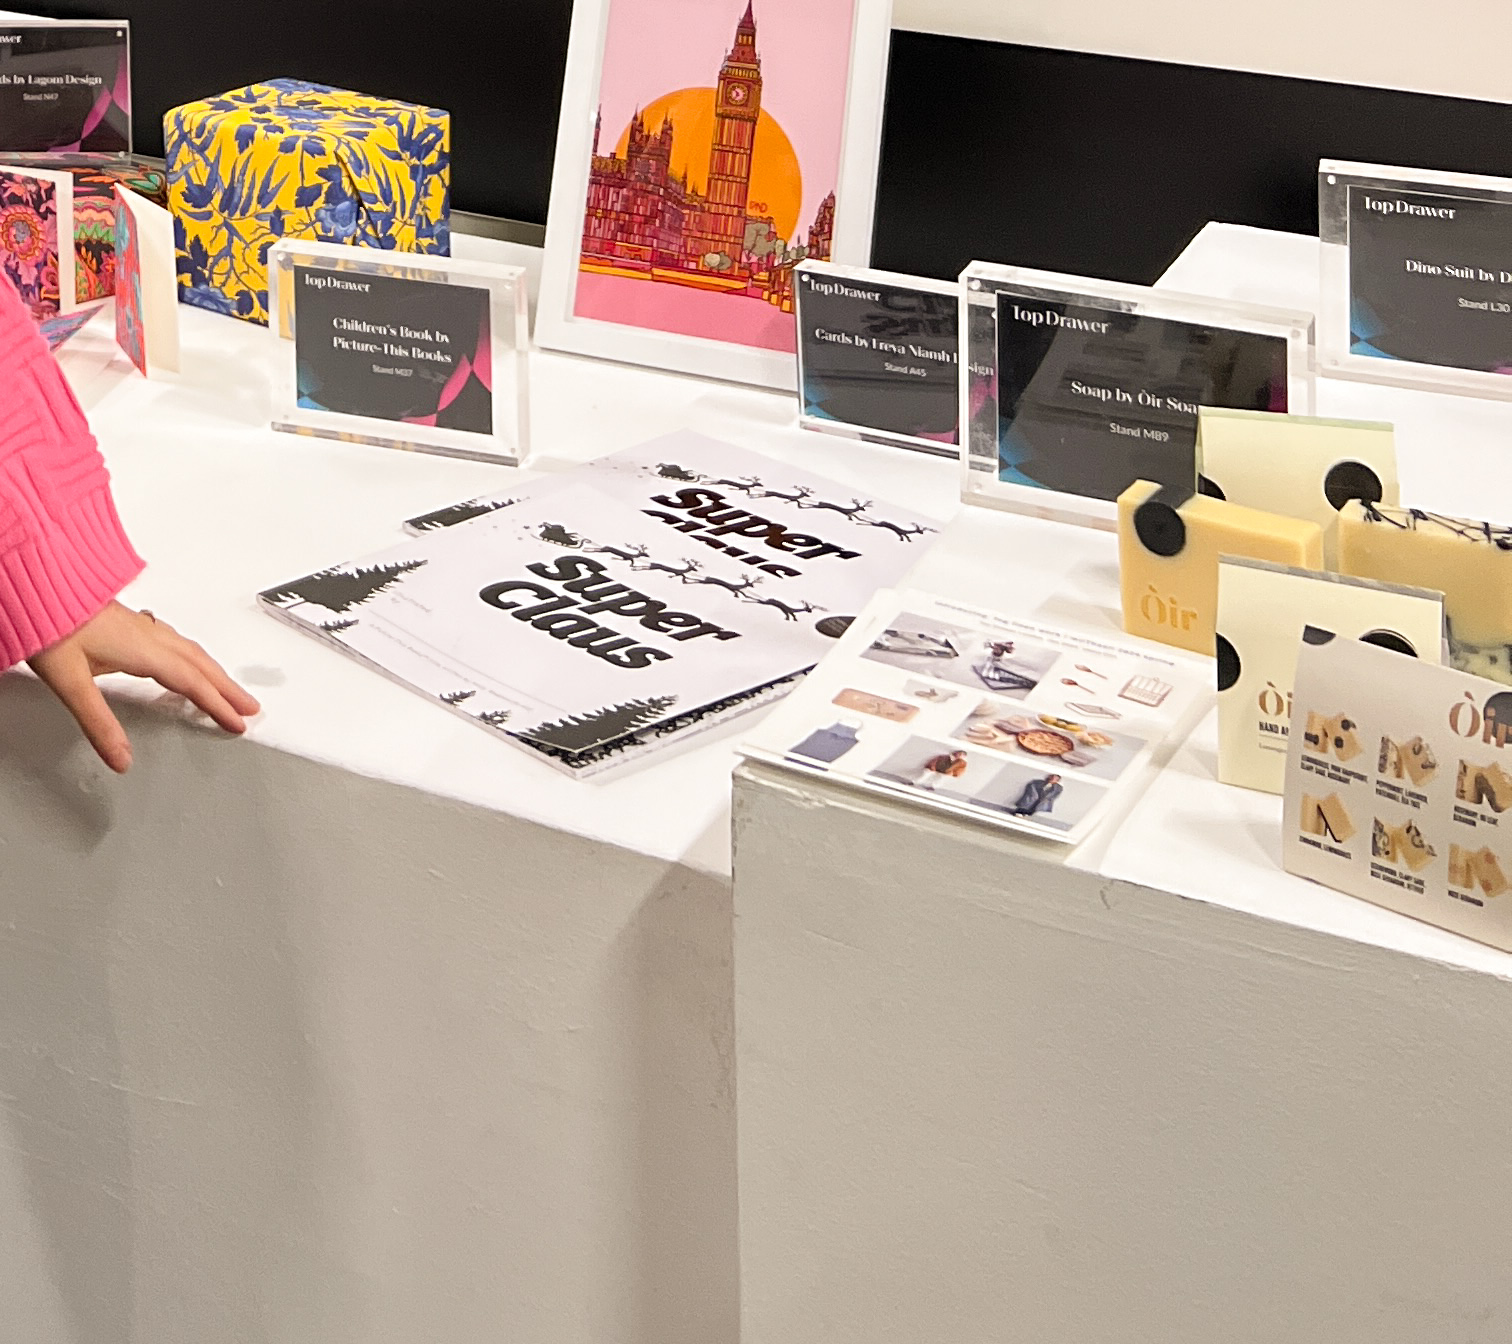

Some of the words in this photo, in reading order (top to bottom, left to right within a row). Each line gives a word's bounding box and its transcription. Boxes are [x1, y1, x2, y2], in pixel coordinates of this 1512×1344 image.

[13, 74, 25, 85] by
[28, 74, 63, 86] Lagom
[65, 74, 102, 86] Design
[1395, 200, 1456, 219] Drawer
[1405, 259, 1442, 276] Dino
[1444, 264, 1475, 281] Suit
[1478, 269, 1495, 282] by
[327, 276, 371, 293] Drawer
[834, 283, 881, 302] Drawer
[1457, 297, 1488, 311] Stand
[333, 316, 397, 337] Children's
[400, 325, 433, 342] Book
[435, 330, 451, 345] by
[1045, 310, 1109, 335] Drawer
[411, 346, 452, 363] Books
[814, 328, 853, 347] Cards
[854, 334, 869, 350] by
[872, 338, 906, 356] Freya
[909, 344, 950, 363] Niamh
[884, 362, 908, 375] Stand
[1070, 380, 1112, 403] Soap
[1115, 386, 1133, 405] by
[1109, 422, 1141, 439] Stand
[1143, 427, 1169, 442] M89
[649, 487, 863, 560] Super
[525, 553, 742, 643] Super
[1141, 585, 1198, 631] Òir
[478, 580, 674, 670] Claus
[1258, 681, 1293, 718] Òi
